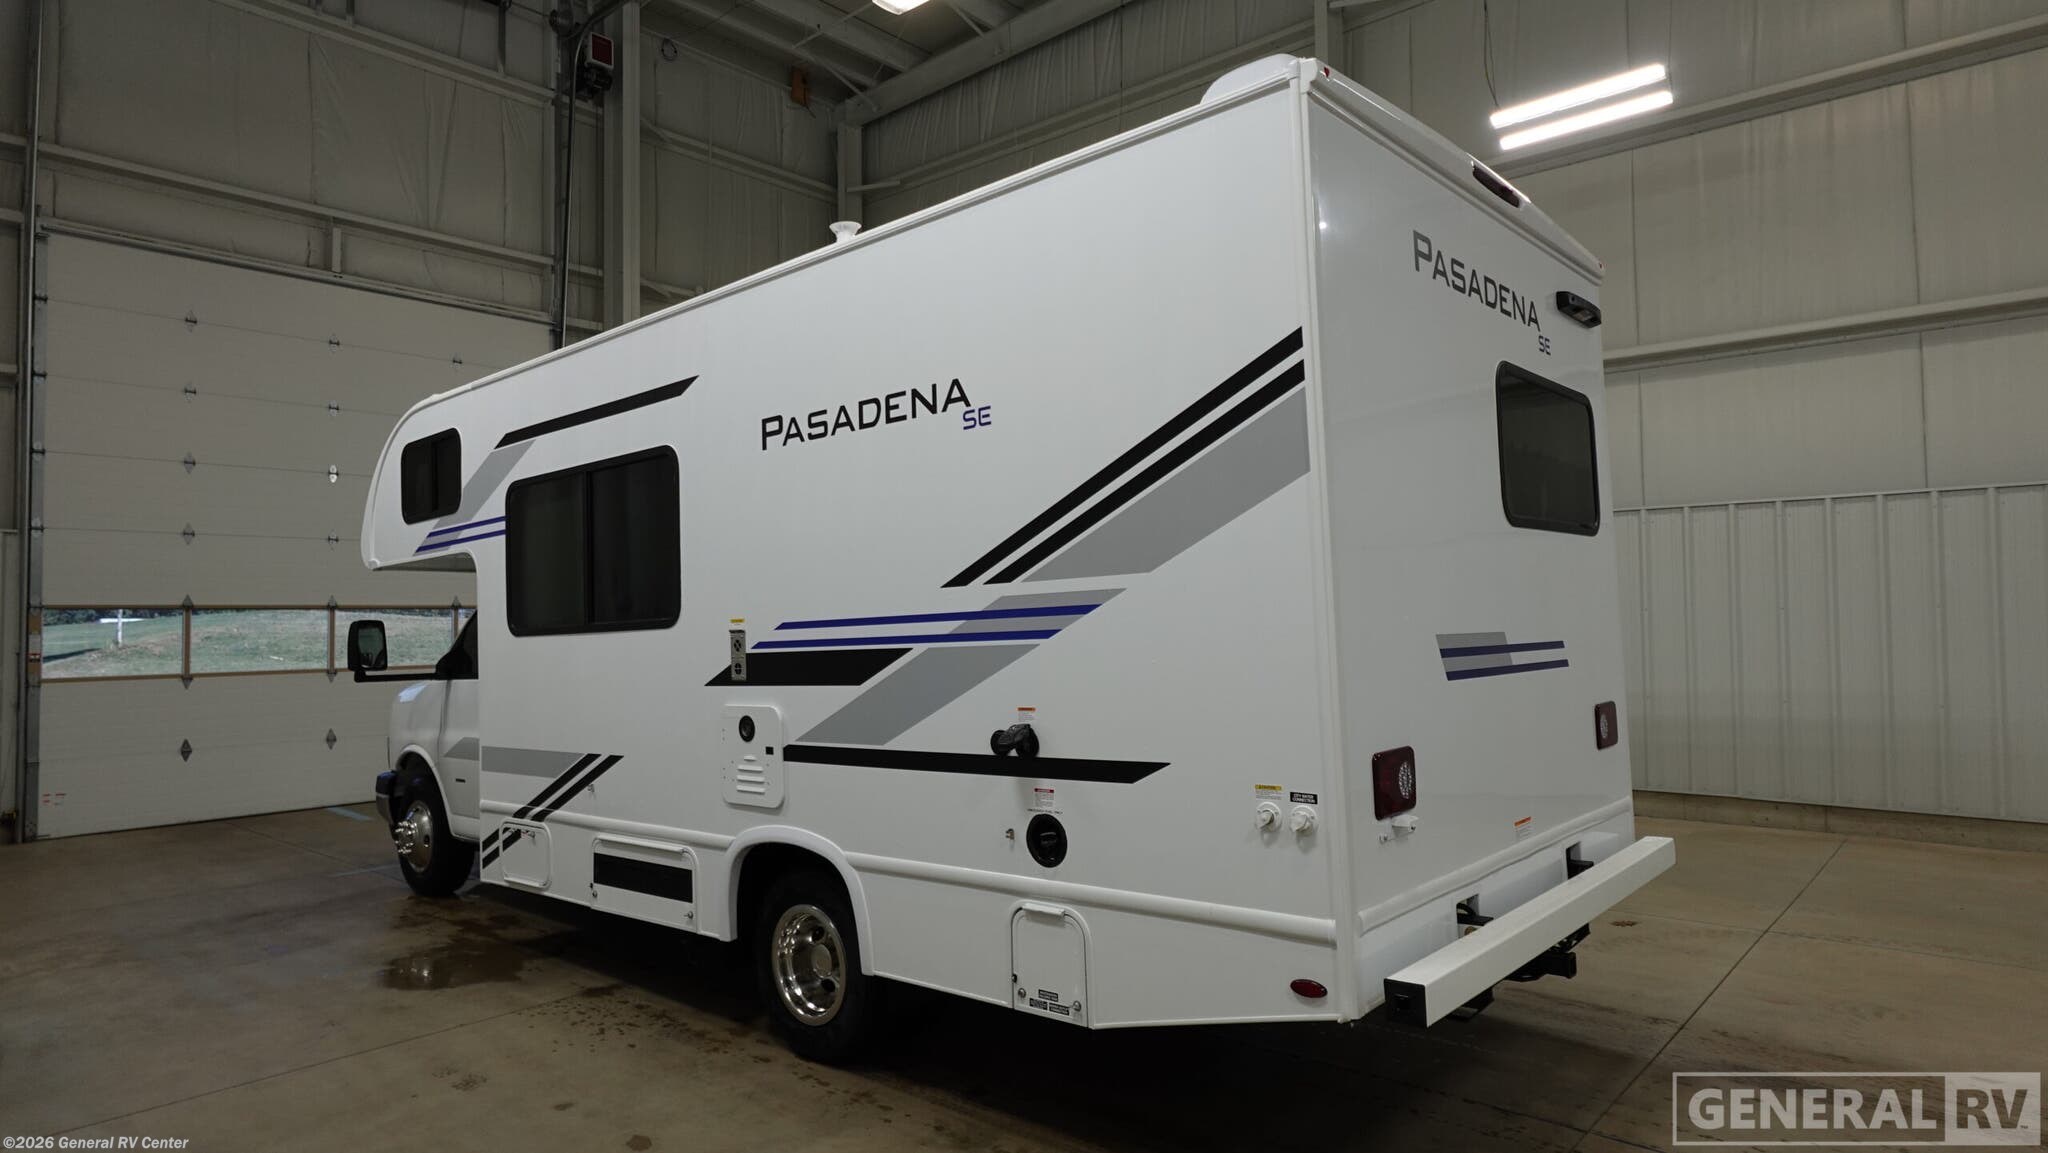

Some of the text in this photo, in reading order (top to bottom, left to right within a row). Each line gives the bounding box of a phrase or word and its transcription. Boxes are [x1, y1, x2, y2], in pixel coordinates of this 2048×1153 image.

[1413, 229, 1541, 332] PASADENA
[1538, 335, 1551, 355] SE
[761, 378, 972, 451] PASADENA
[963, 405, 992, 430] SE
